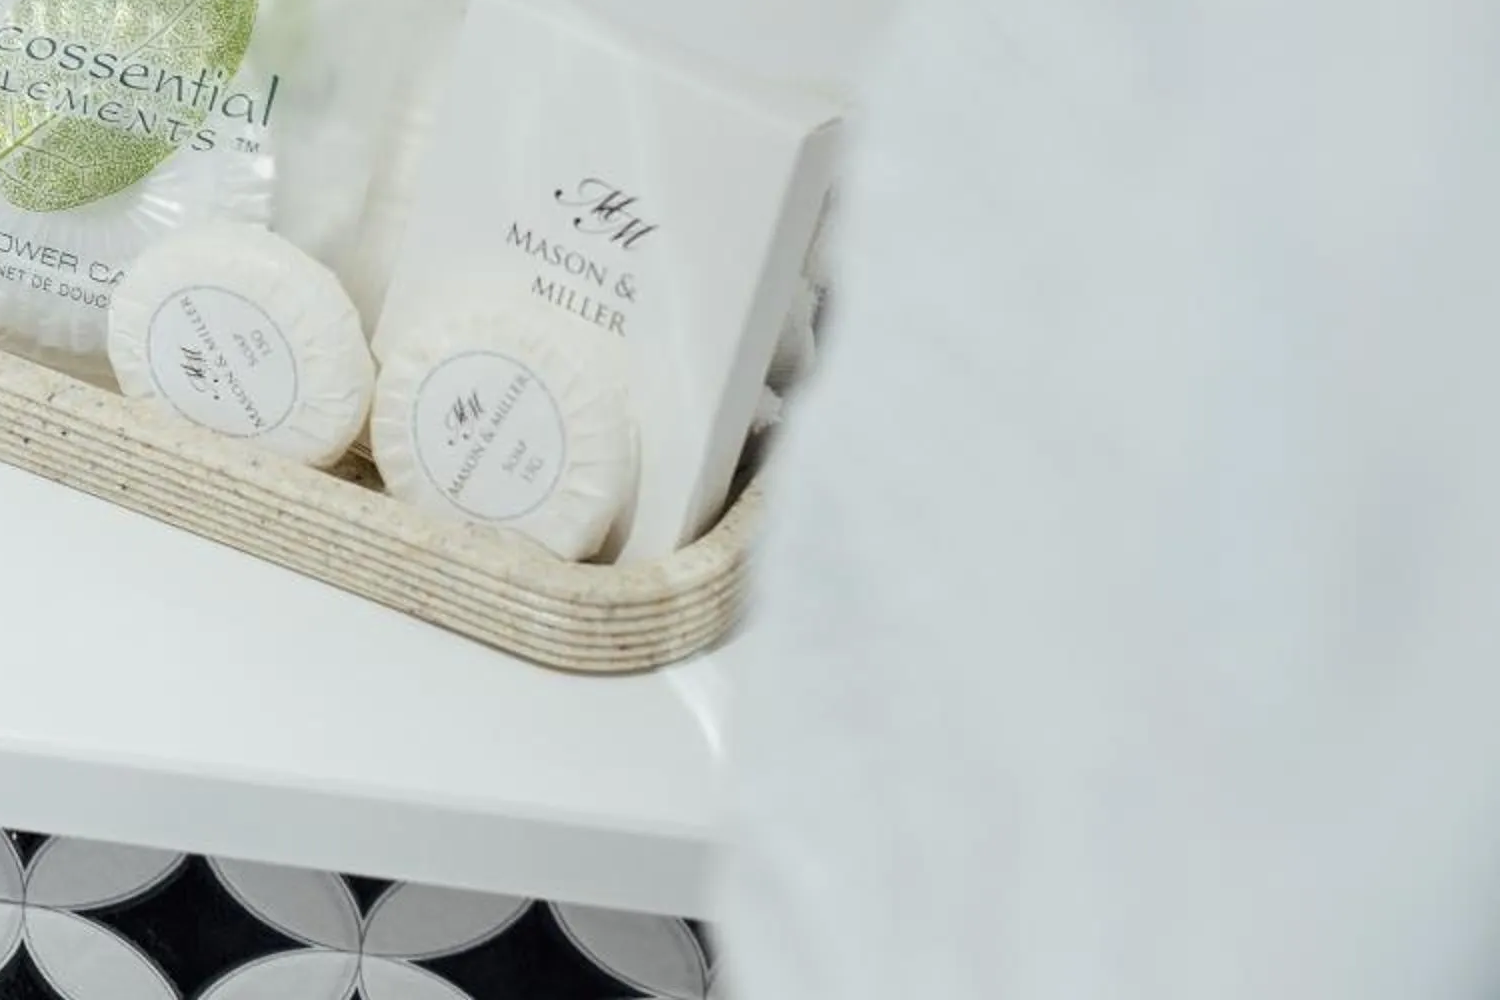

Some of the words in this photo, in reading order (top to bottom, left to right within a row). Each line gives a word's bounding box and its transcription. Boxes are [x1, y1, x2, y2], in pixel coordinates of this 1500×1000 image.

[88, 259, 126, 287] CA
[505, 221, 608, 288] MASON
[613, 272, 638, 305] &
[30, 274, 53, 292] DE
[56, 282, 111, 309] DOUC
[530, 275, 626, 338] MILLER
